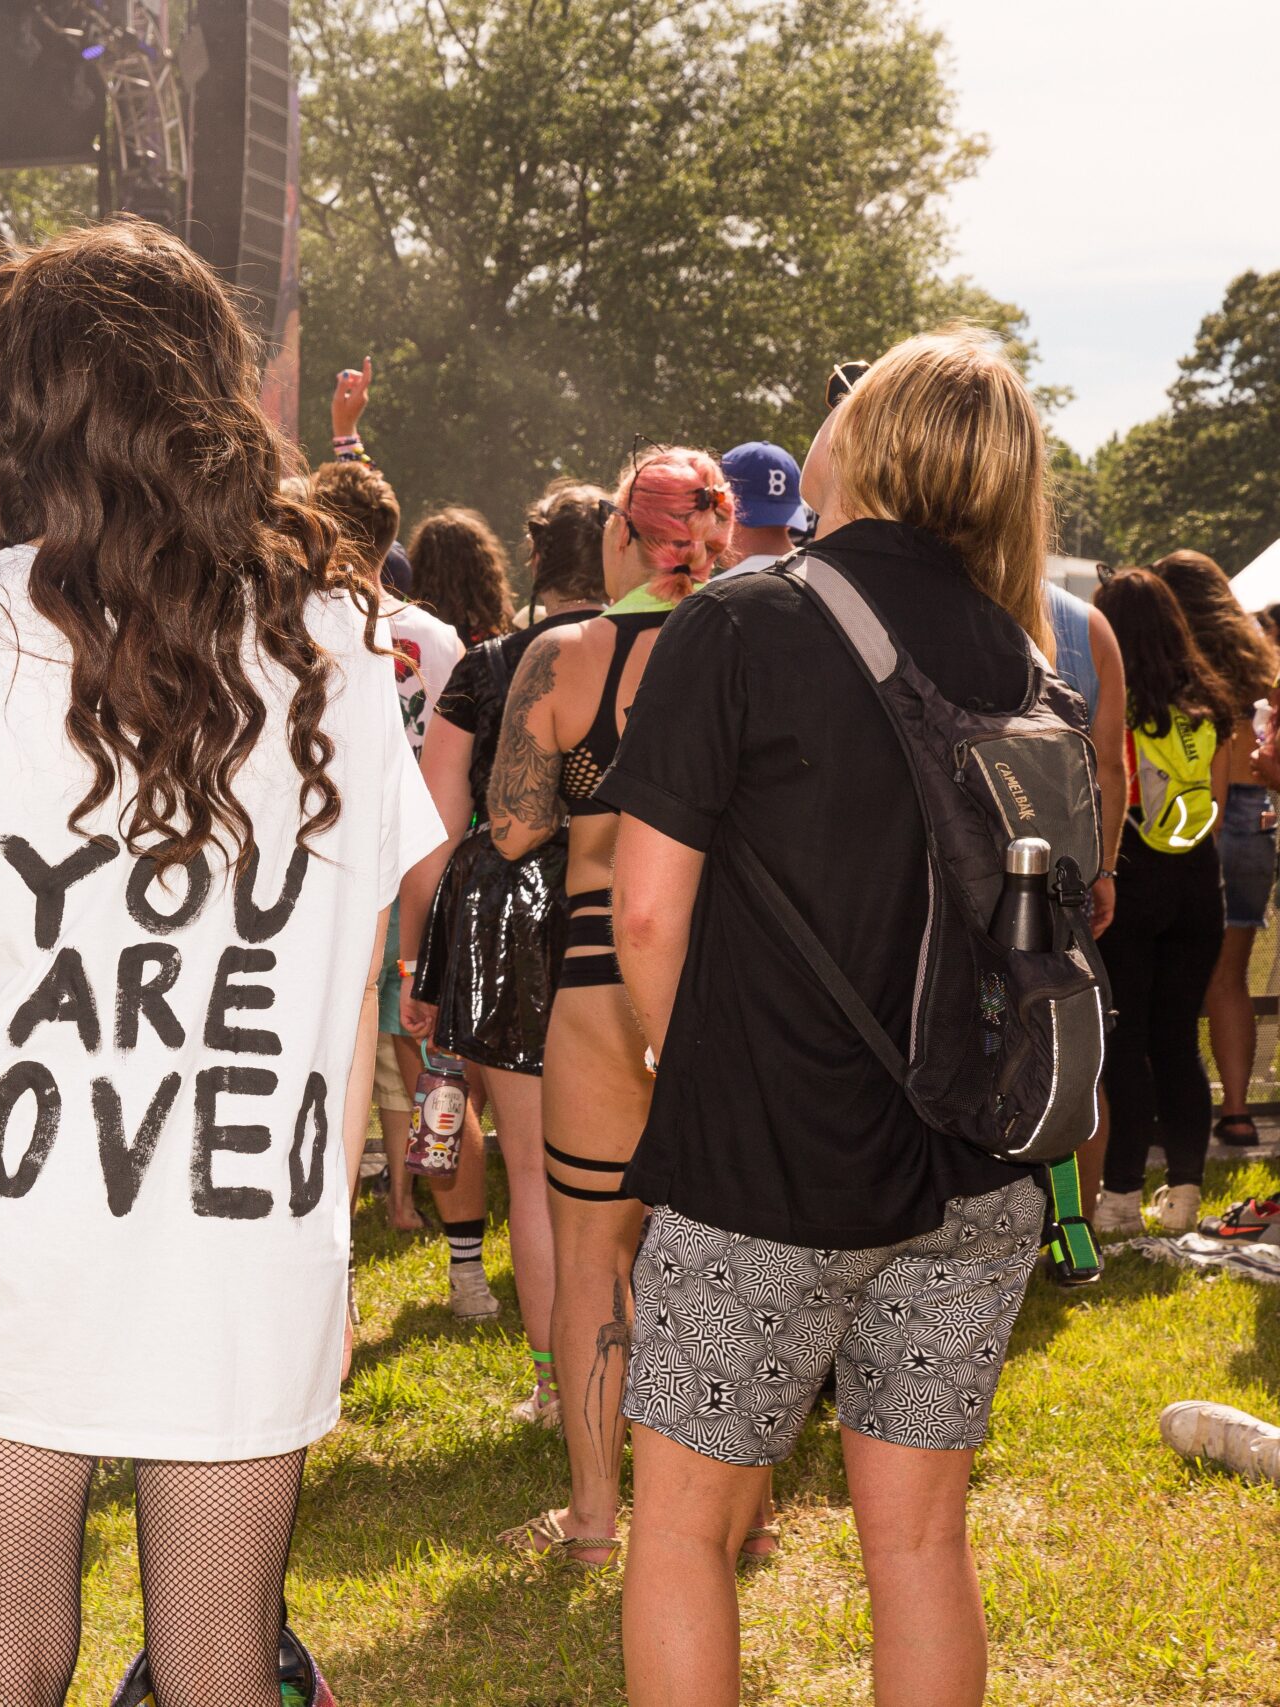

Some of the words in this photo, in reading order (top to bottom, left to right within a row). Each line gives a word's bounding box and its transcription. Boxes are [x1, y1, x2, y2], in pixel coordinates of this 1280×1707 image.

[768, 469, 786, 496] B
[994, 762, 1036, 820] CAMELBAK
[7, 942, 283, 1056] ARE
